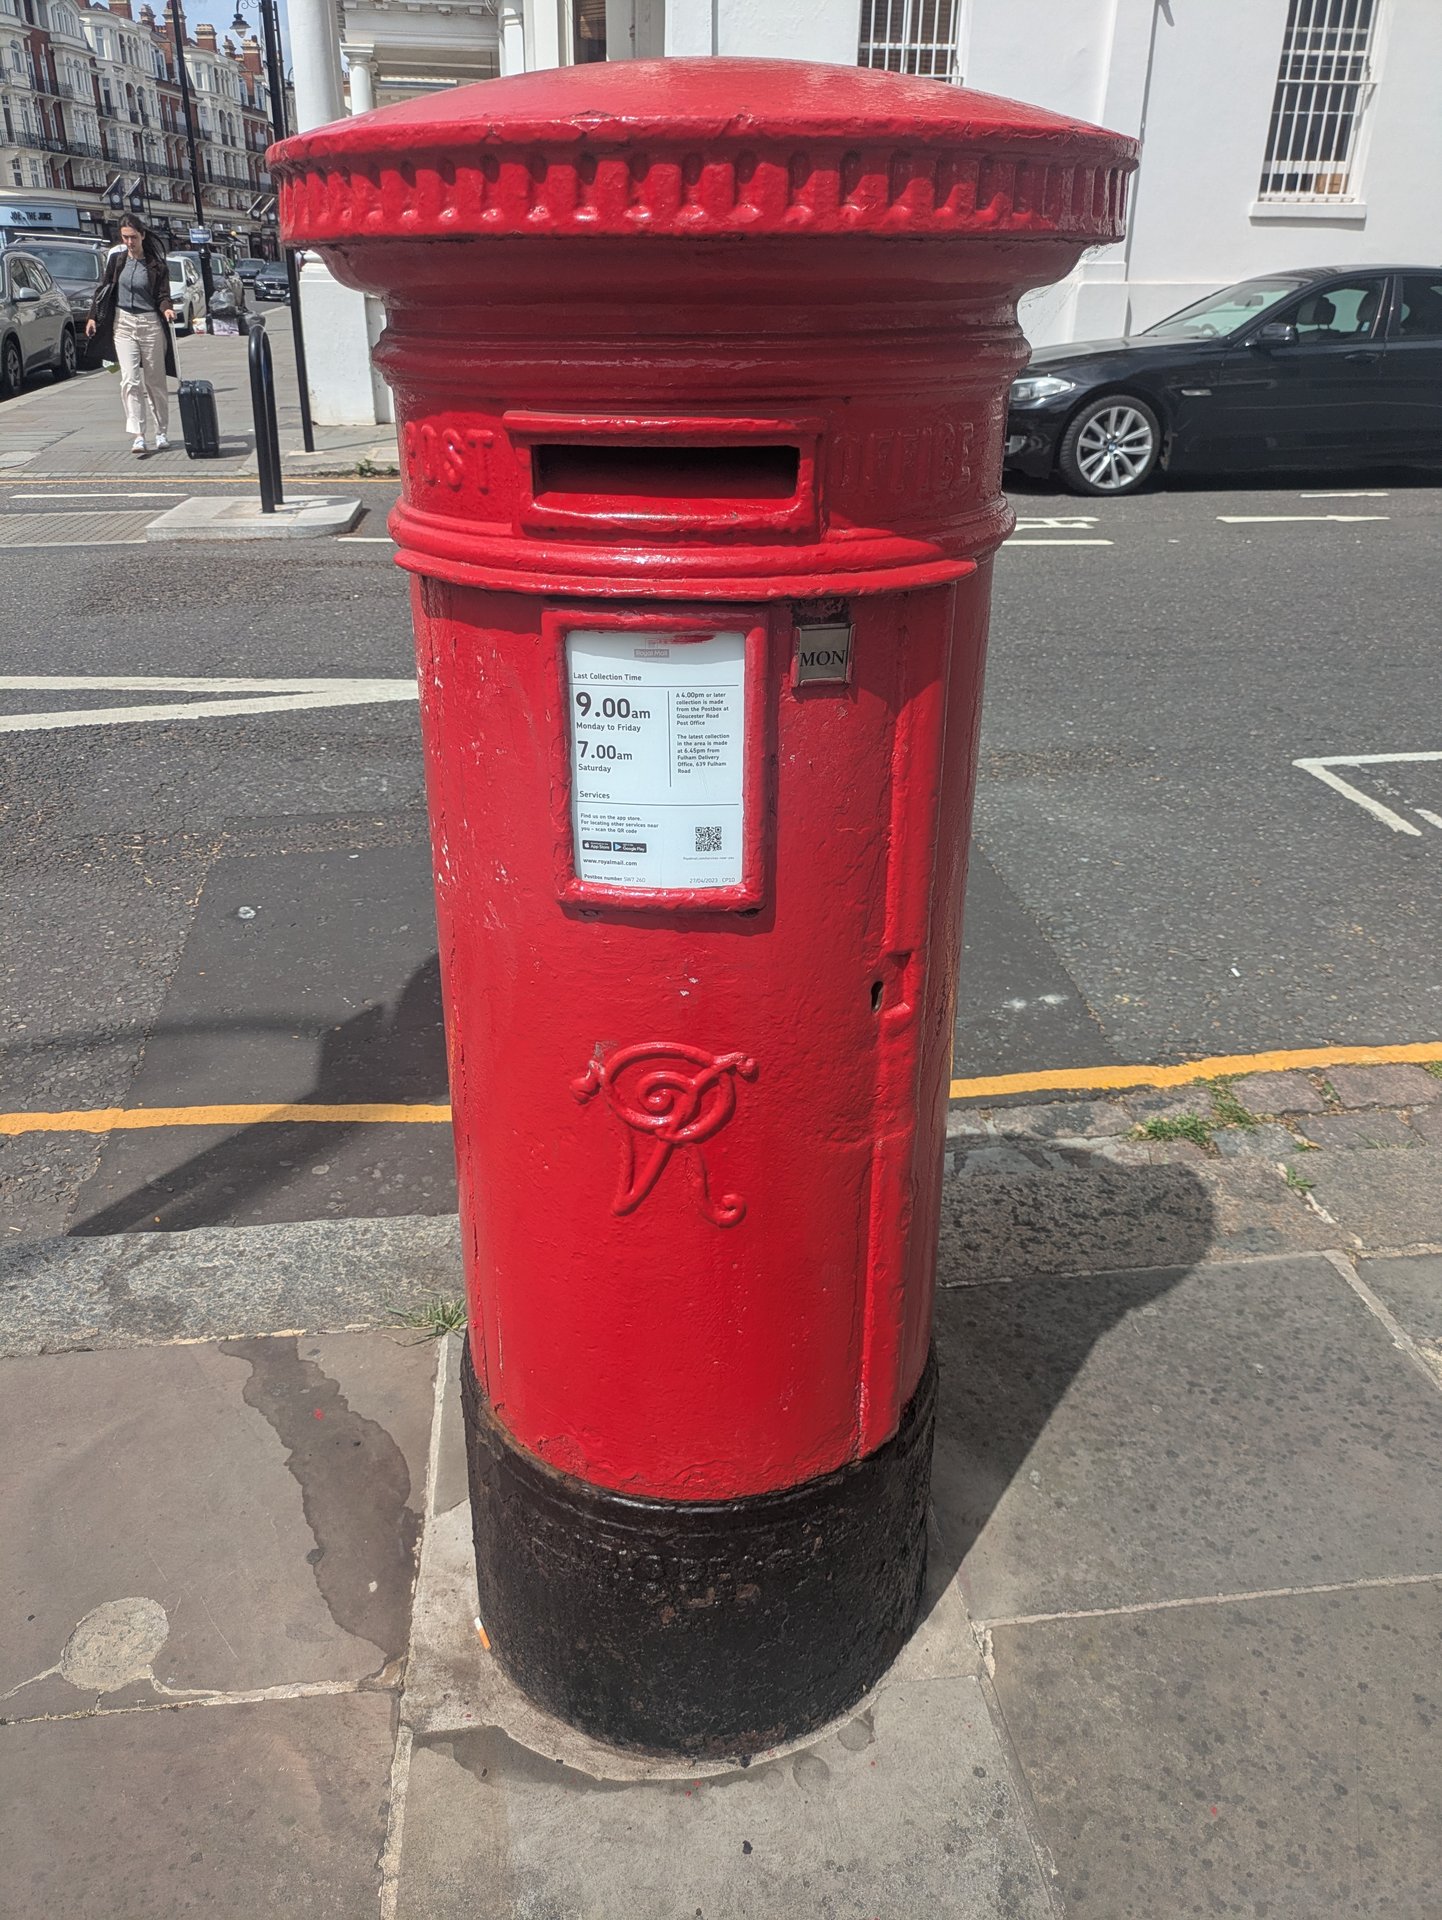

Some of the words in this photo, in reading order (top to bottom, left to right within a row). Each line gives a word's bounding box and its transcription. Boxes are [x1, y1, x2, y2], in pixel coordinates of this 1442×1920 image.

[404, 420, 494, 494] POST
[800, 650, 846, 667] MON
[575, 691, 651, 719] 9.00am
[576, 722, 605, 732] Monday
[607, 723, 615, 731] to
[617, 723, 641, 732] Friday
[577, 741, 632, 760] 7.00am
[578, 764, 611, 773] Saturday
[580, 791, 610, 799] Services
